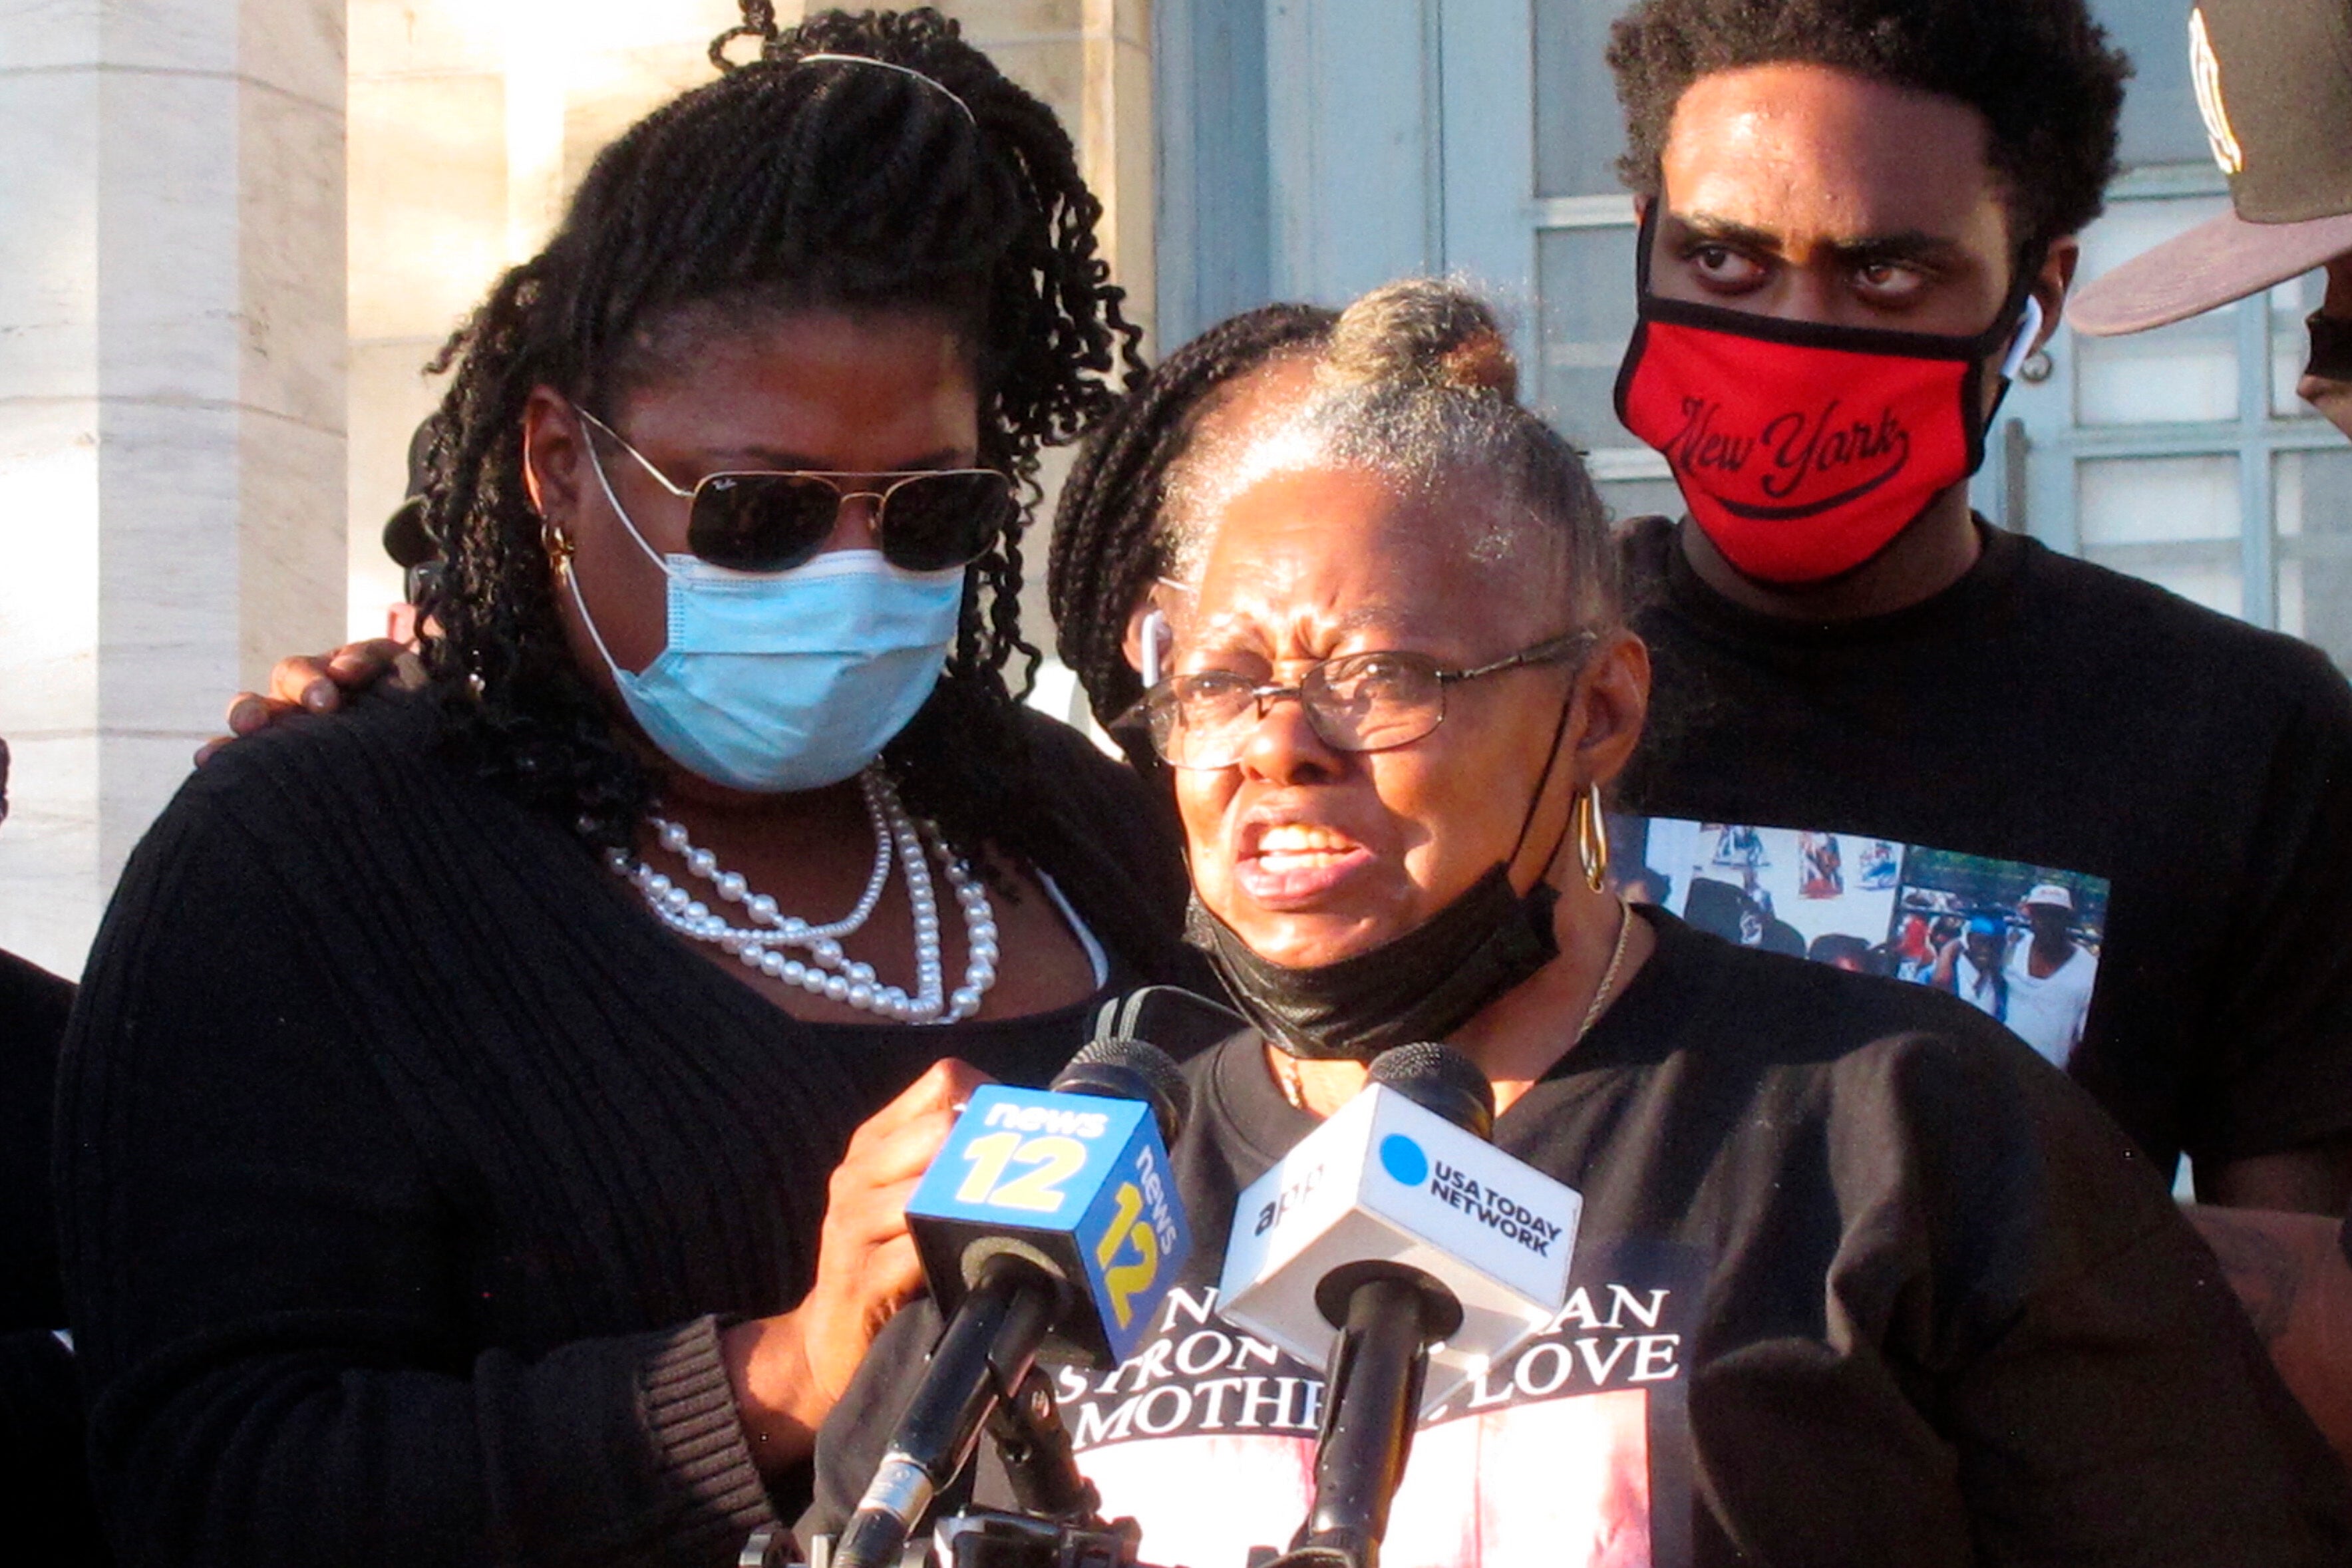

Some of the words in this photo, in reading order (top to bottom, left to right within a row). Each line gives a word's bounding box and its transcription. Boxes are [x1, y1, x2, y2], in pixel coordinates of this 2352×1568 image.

[1665, 396, 1757, 478] New
[1761, 400, 1902, 498] York
[983, 1102, 1108, 1138] news
[953, 1132, 1087, 1213] 12
[1135, 1144, 1178, 1256] news
[1430, 1178, 1550, 1258] NETWORK
[1434, 1160, 1481, 1200] USA
[1484, 1187, 1563, 1242] TODAY
[1096, 1181, 1158, 1330] 12
[1056, 1330, 1279, 1404] STRON
[1538, 1283, 1671, 1336] AN
[1072, 1376, 1325, 1451] MOTHE
[1466, 1334, 1681, 1408] LOVE
